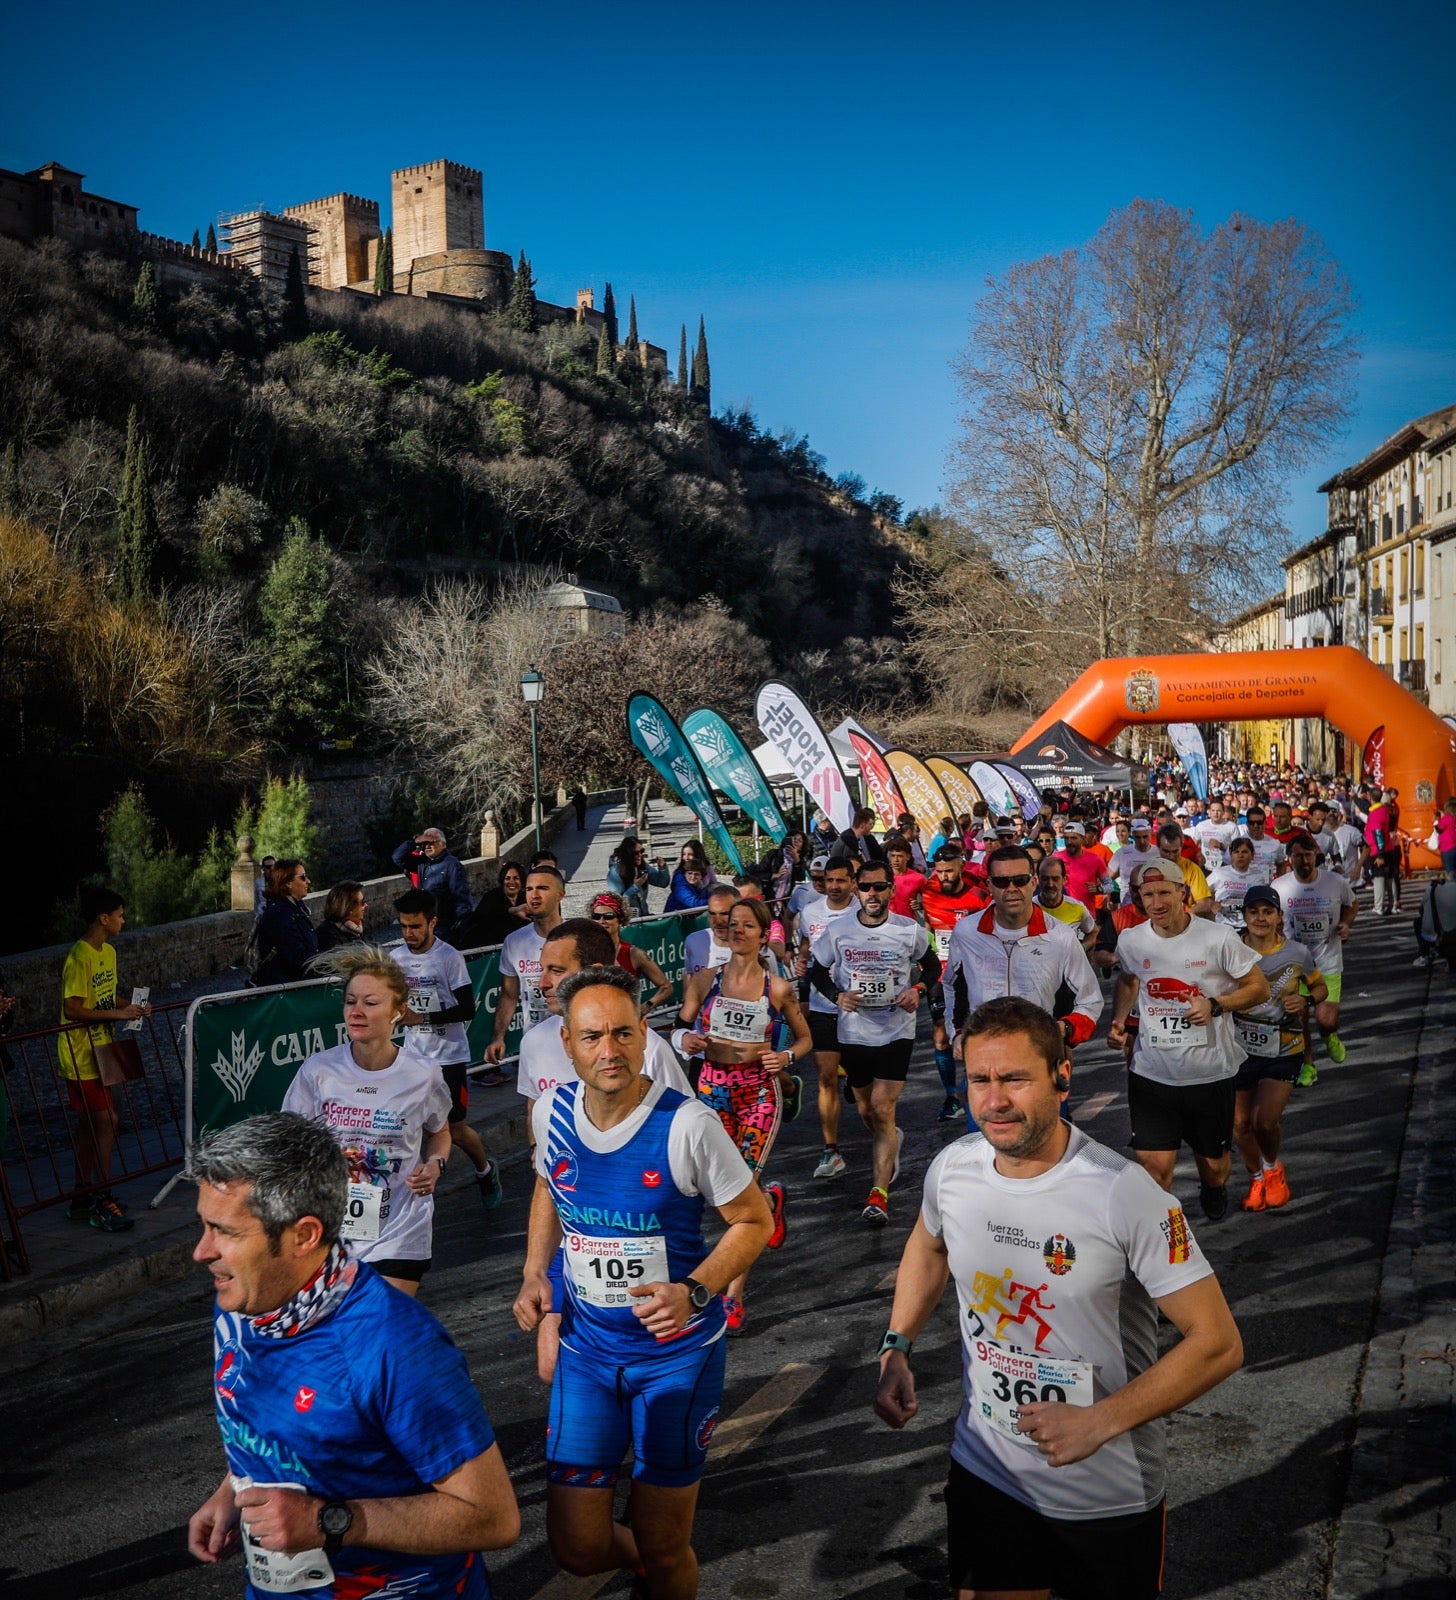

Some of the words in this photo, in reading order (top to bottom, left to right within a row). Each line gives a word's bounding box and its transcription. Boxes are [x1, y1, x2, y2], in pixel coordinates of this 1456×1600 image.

[1164, 678, 1246, 692] AYUNTAMIENTO
[1249, 678, 1261, 688] DE
[1264, 675, 1317, 687] GRANADA
[1176, 689, 1236, 703] Concejalía
[1238, 689, 1252, 700] de
[1256, 687, 1305, 702] Deportes
[1287, 897, 1294, 908] 9
[1302, 922, 1322, 930] 140
[844, 948, 852, 961] 9
[519, 959, 525, 973] 9
[859, 982, 886, 994] 538
[409, 995, 431, 1008] 317
[715, 998, 723, 1008] 9
[724, 1010, 755, 1027] 197
[1147, 1006, 1155, 1017] 9
[1160, 1016, 1192, 1030] 175
[1241, 1030, 1268, 1045] 199
[271, 1027, 326, 1067] CAJA
[330, 1102, 371, 1117] Carrera
[329, 1114, 372, 1129] Solidaria
[372, 1122, 403, 1131] Granada
[344, 1199, 364, 1218] 0
[987, 1220, 1024, 1237] fuerzas
[570, 1235, 581, 1252] 9
[581, 1237, 620, 1249] Carrera
[993, 1233, 1040, 1250] armadas
[581, 1246, 624, 1257] Solidaria
[588, 1257, 645, 1280] 105
[976, 1340, 988, 1362] 9
[988, 1346, 1033, 1370] Carrera
[1038, 1362, 1055, 1371] Ave
[988, 1356, 1037, 1381] Solidaria
[1037, 1374, 1077, 1386] Granada
[991, 1370, 1067, 1407] 360
